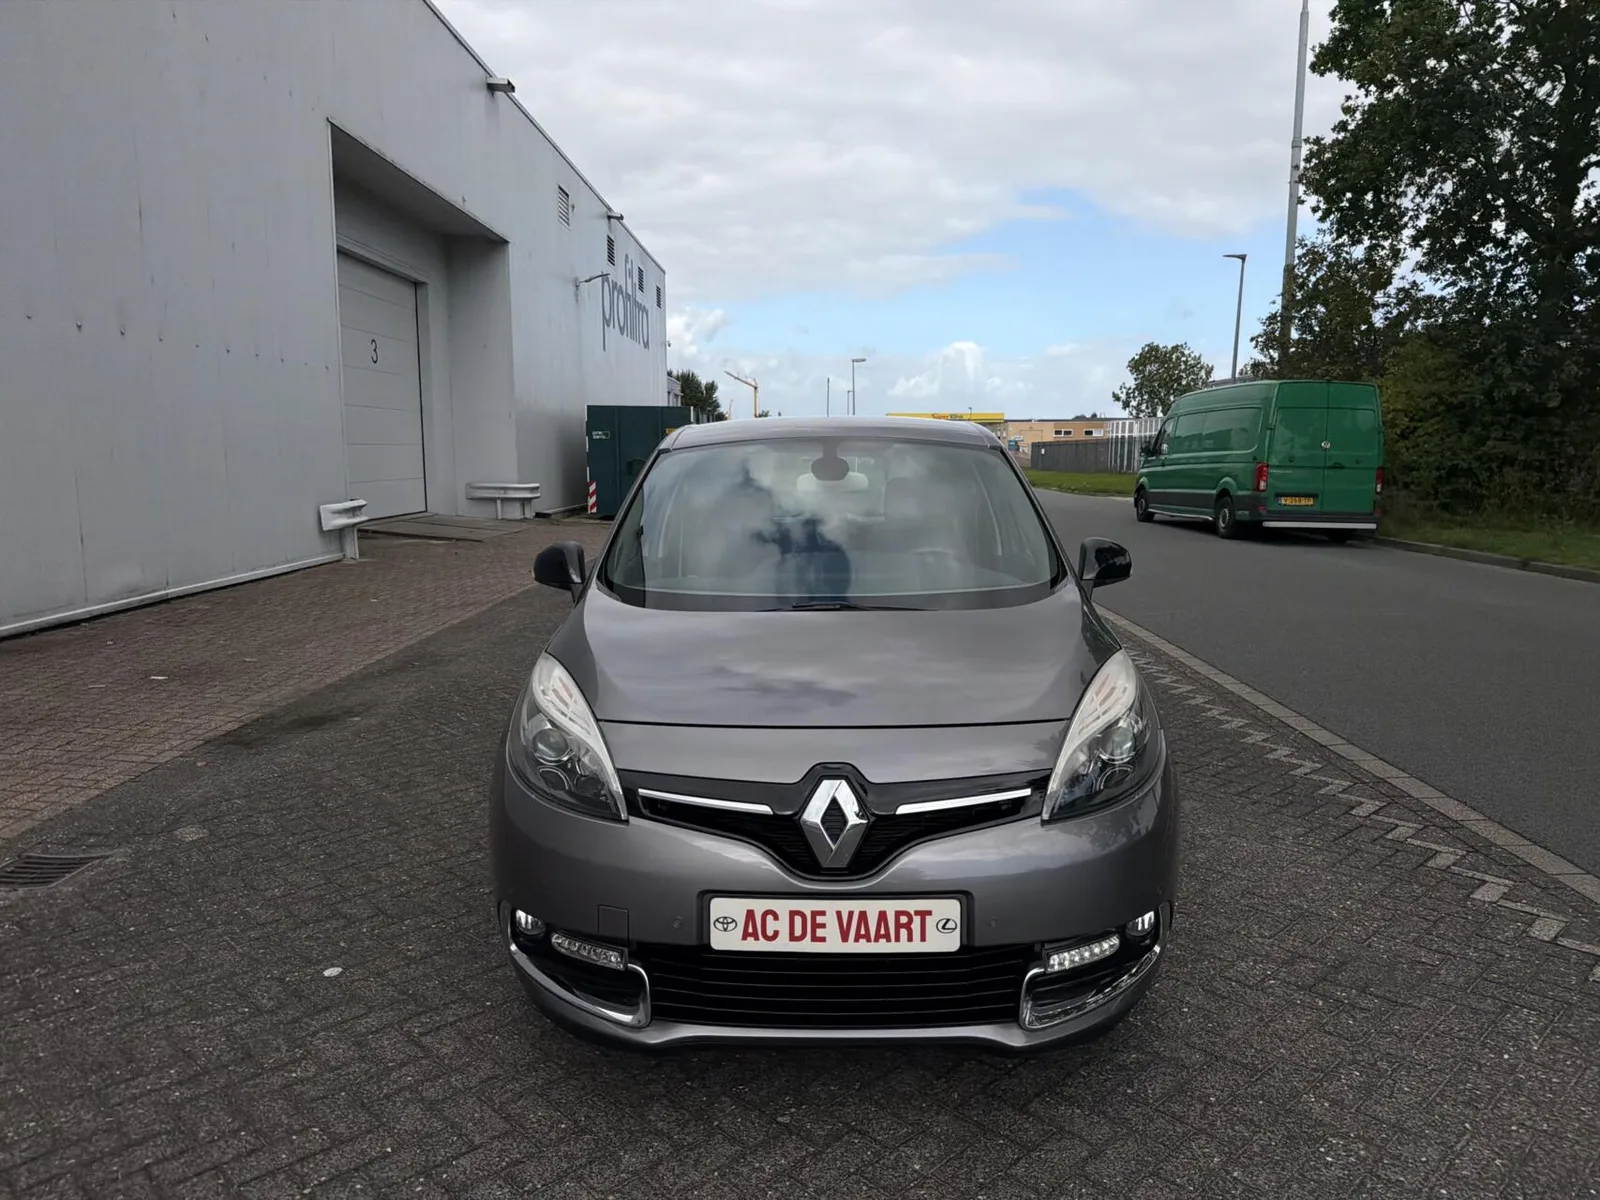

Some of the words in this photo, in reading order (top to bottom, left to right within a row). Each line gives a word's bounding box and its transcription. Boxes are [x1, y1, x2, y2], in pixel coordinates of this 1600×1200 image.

[601, 253, 650, 352] profiltra
[370, 338, 379, 365] 3
[741, 909, 780, 942] AC
[788, 910, 827, 943] DE
[835, 910, 933, 943] VAART
